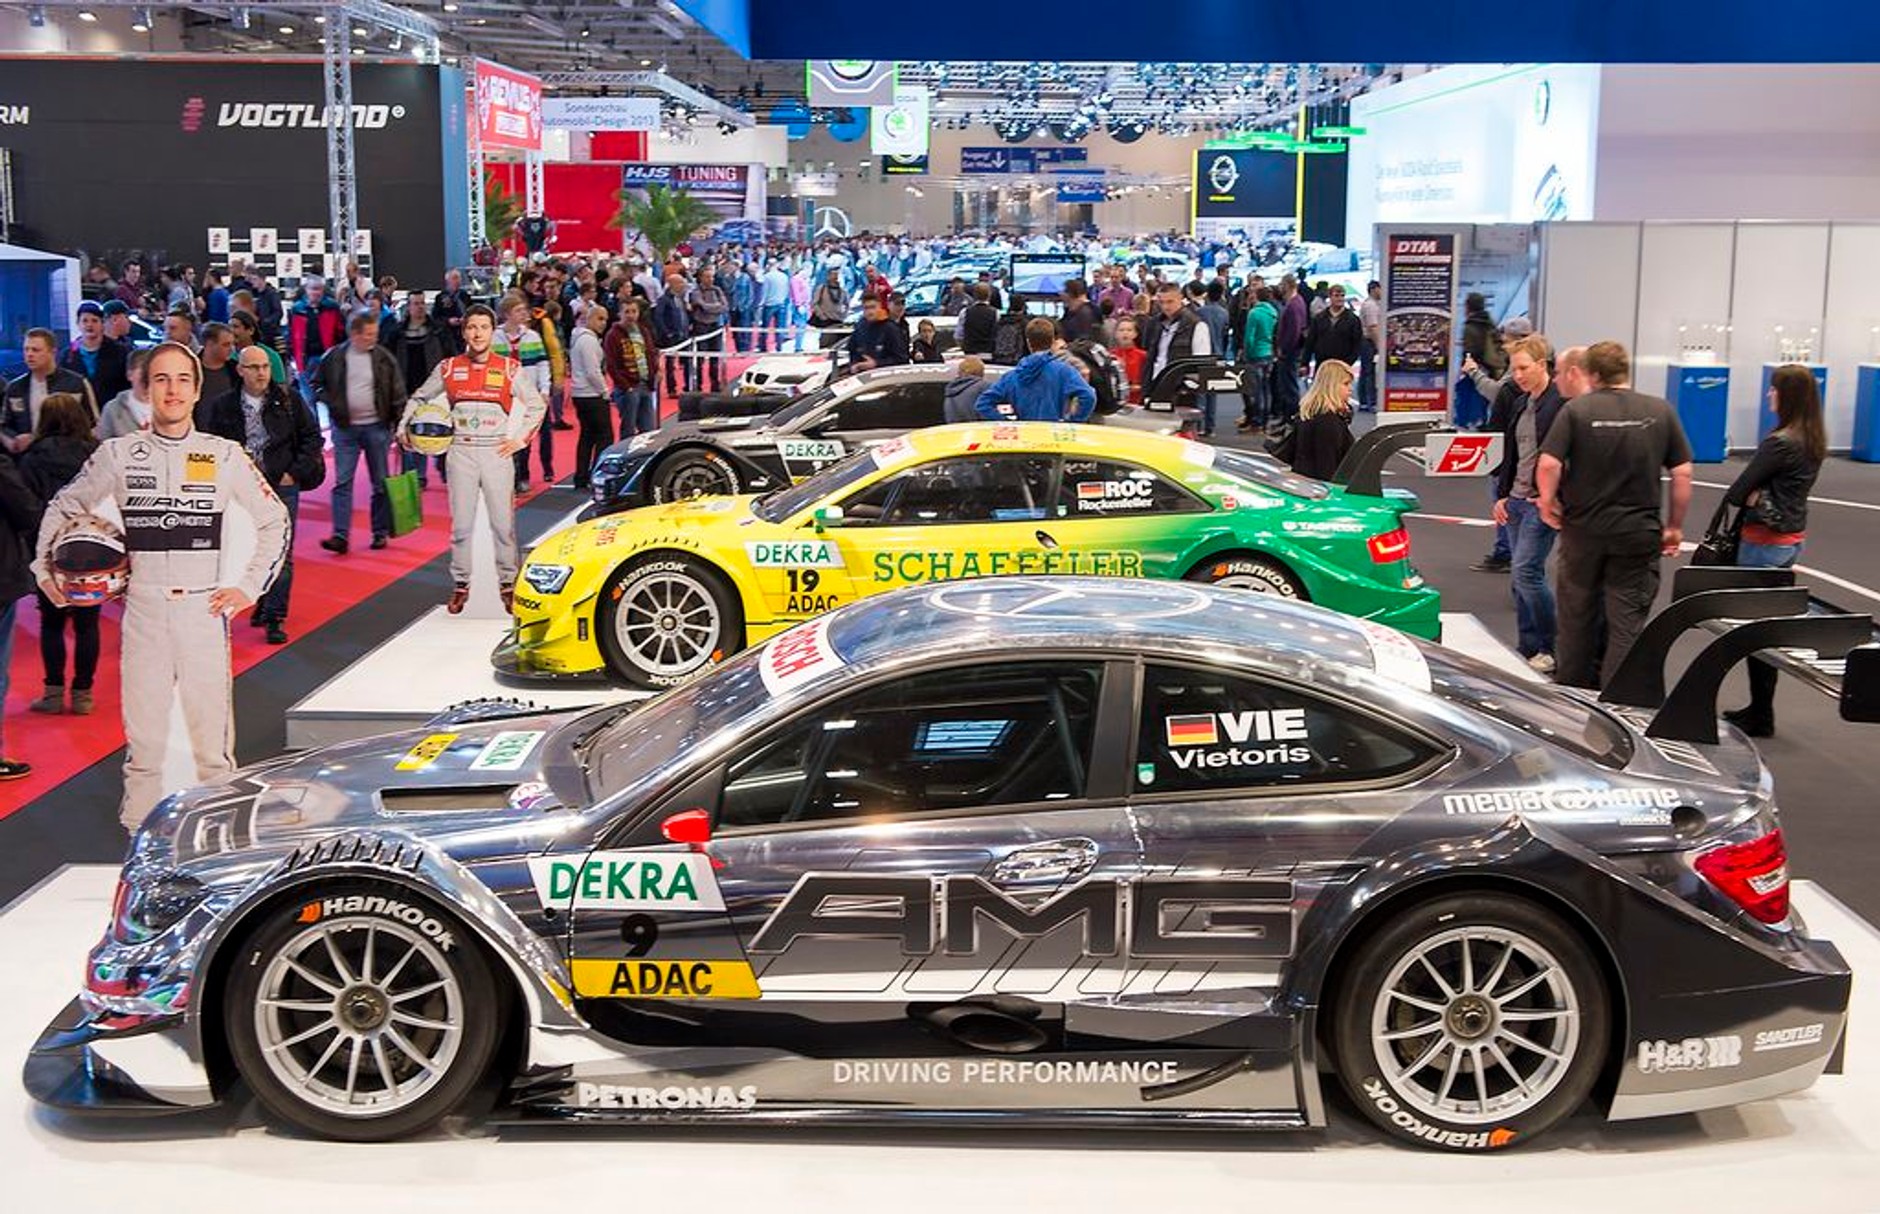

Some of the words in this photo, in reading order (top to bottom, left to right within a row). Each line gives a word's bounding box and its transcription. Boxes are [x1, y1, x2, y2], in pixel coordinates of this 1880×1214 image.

[626, 167, 671, 178] HJS
[679, 167, 736, 180] TUNING
[1396, 241, 1437, 253] DTM
[186, 453, 215, 464] ADAC
[785, 444, 836, 457] DEKRA
[1105, 479, 1153, 498] ROC
[755, 544, 831, 563] DEKRA
[787, 570, 820, 592] 19
[787, 595, 838, 613] ADAC
[1218, 709, 1309, 743] VIE
[1169, 744, 1311, 769] Vietoris
[550, 861, 698, 900] DEKRA
[747, 872, 1298, 960] AMG
[620, 913, 659, 957] 9
[609, 963, 712, 995] ADAC
[1637, 1038, 1704, 1073] H&R
[833, 1061, 951, 1084] DRIVING
[963, 1061, 1178, 1084] PERFORMANCE
[577, 1084, 757, 1110] PETRONAS
